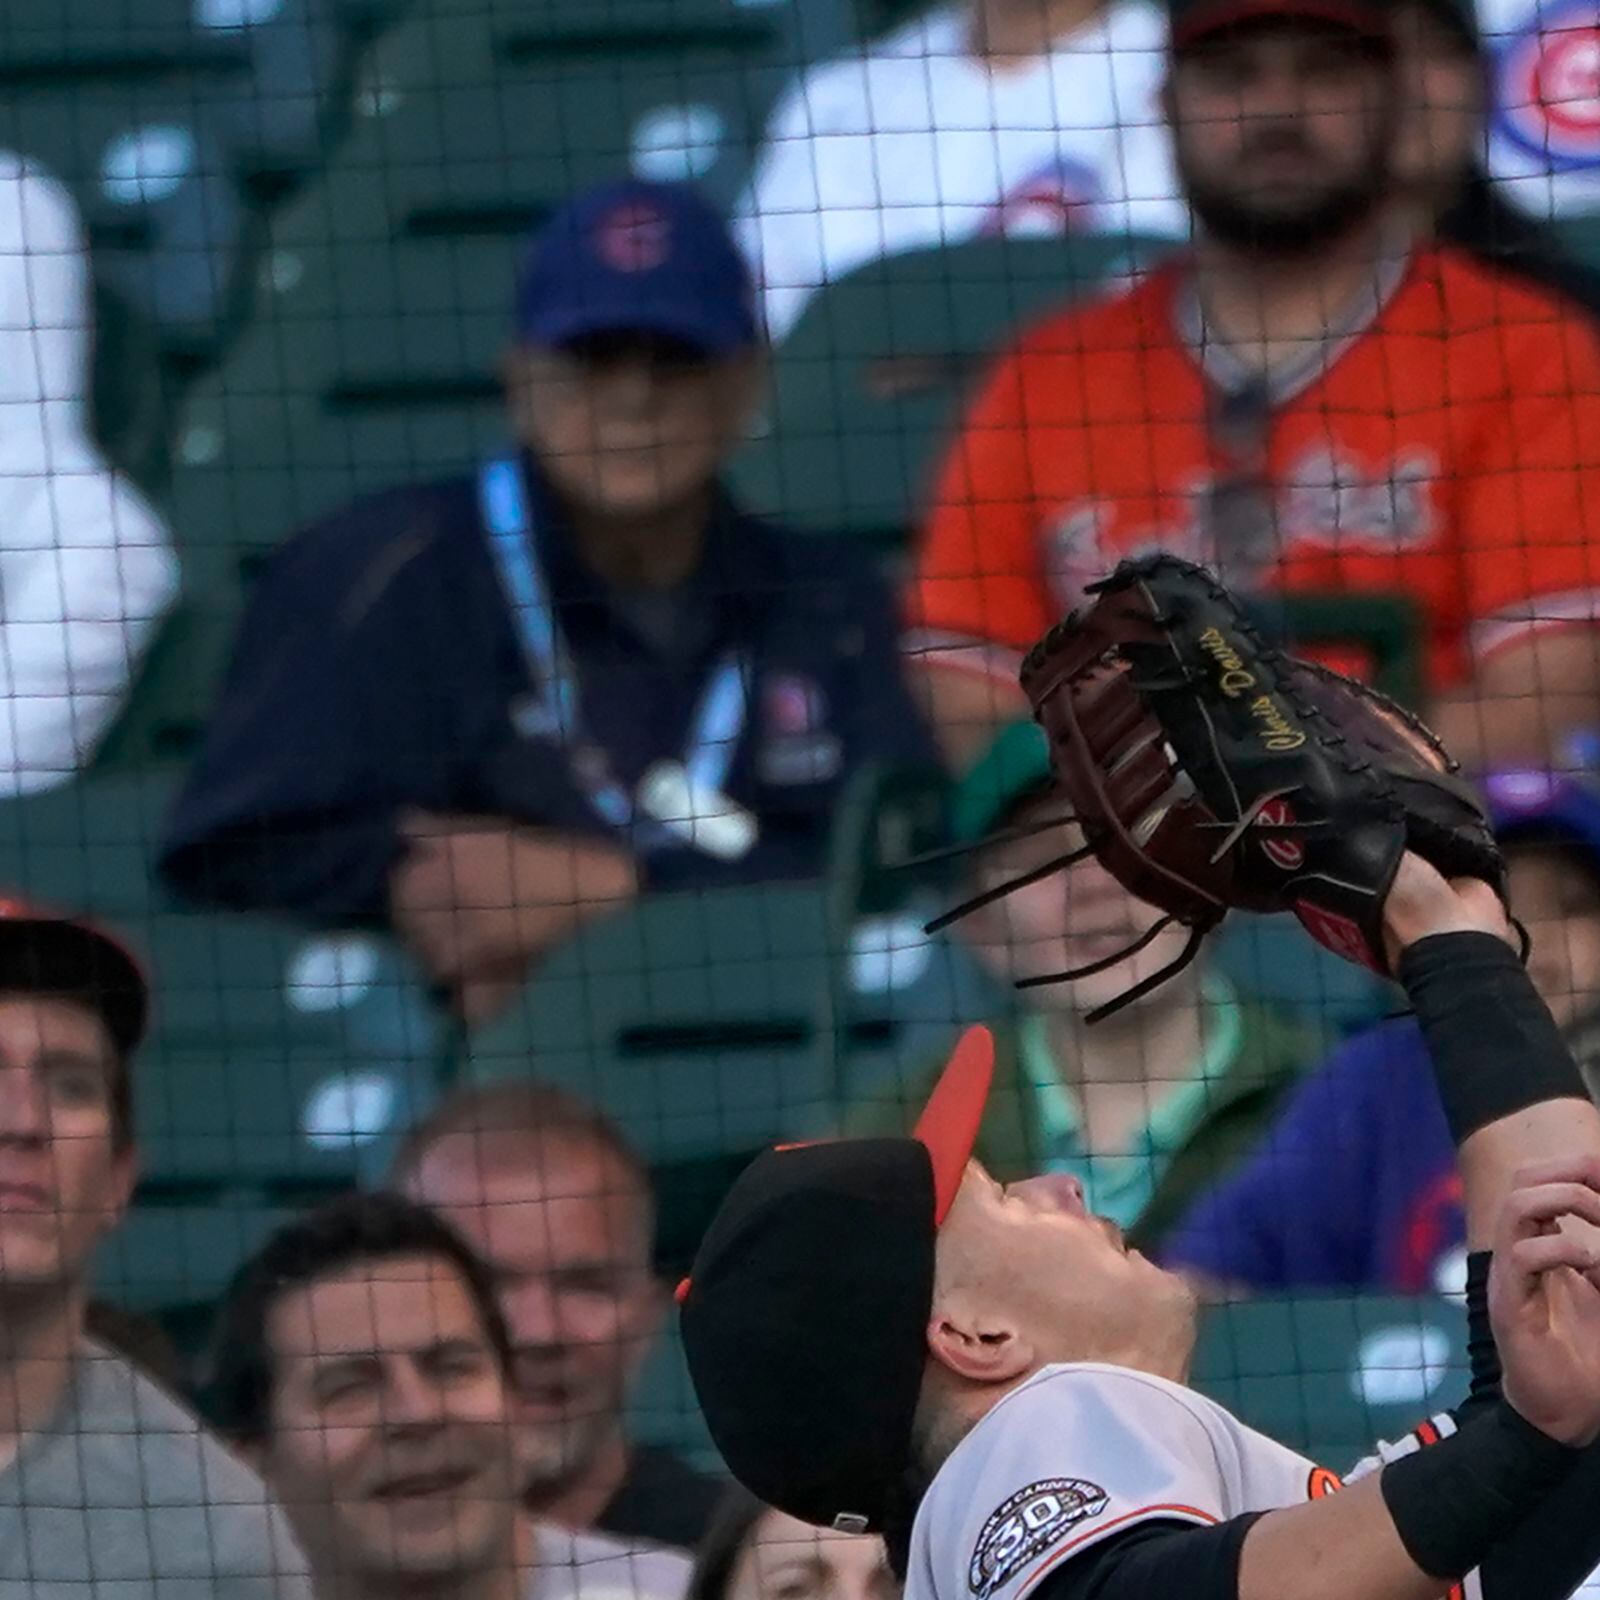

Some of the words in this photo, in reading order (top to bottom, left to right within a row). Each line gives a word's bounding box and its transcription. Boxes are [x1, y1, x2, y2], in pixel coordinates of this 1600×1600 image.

[1199, 627, 1256, 698] Davis
[1251, 695, 1306, 751] Chris
[988, 1494, 1062, 1560] 30
